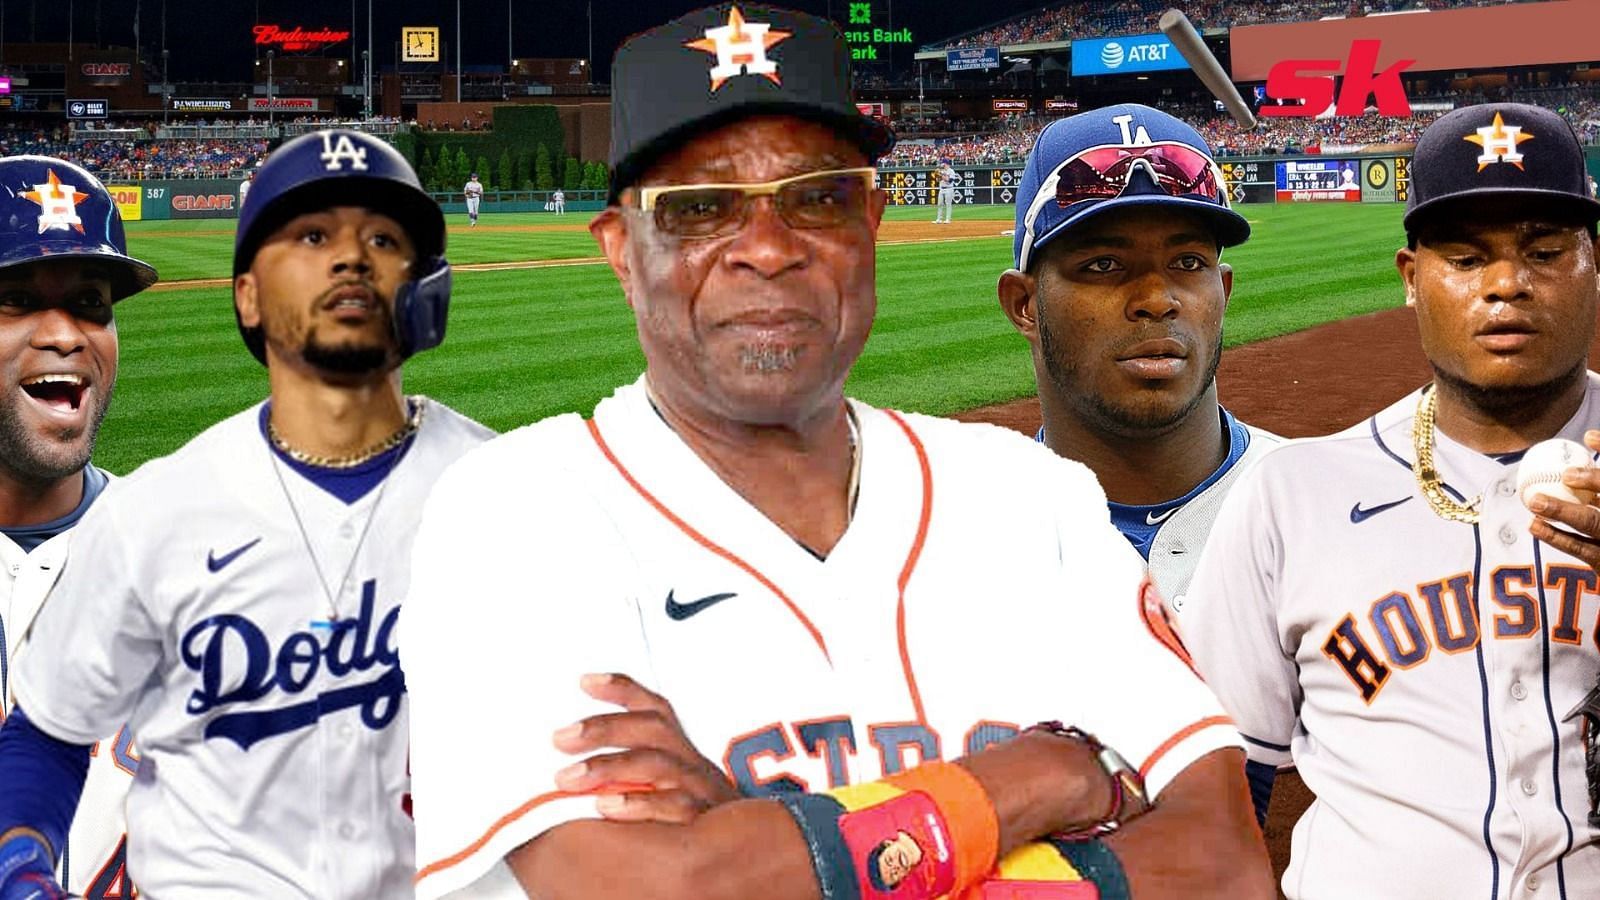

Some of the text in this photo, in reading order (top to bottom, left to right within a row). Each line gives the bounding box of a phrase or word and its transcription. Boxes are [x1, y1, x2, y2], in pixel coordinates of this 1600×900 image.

[253, 25, 350, 43] Budweiser
[873, 28, 912, 42] Bank
[1128, 43, 1170, 62] AT&T
[82, 63, 131, 75] GIANT
[321, 130, 368, 170] LA
[1374, 170, 1381, 180] R
[147, 188, 165, 199] 387
[172, 195, 236, 211] GIANT
[1320, 563, 1600, 707] HOUST
